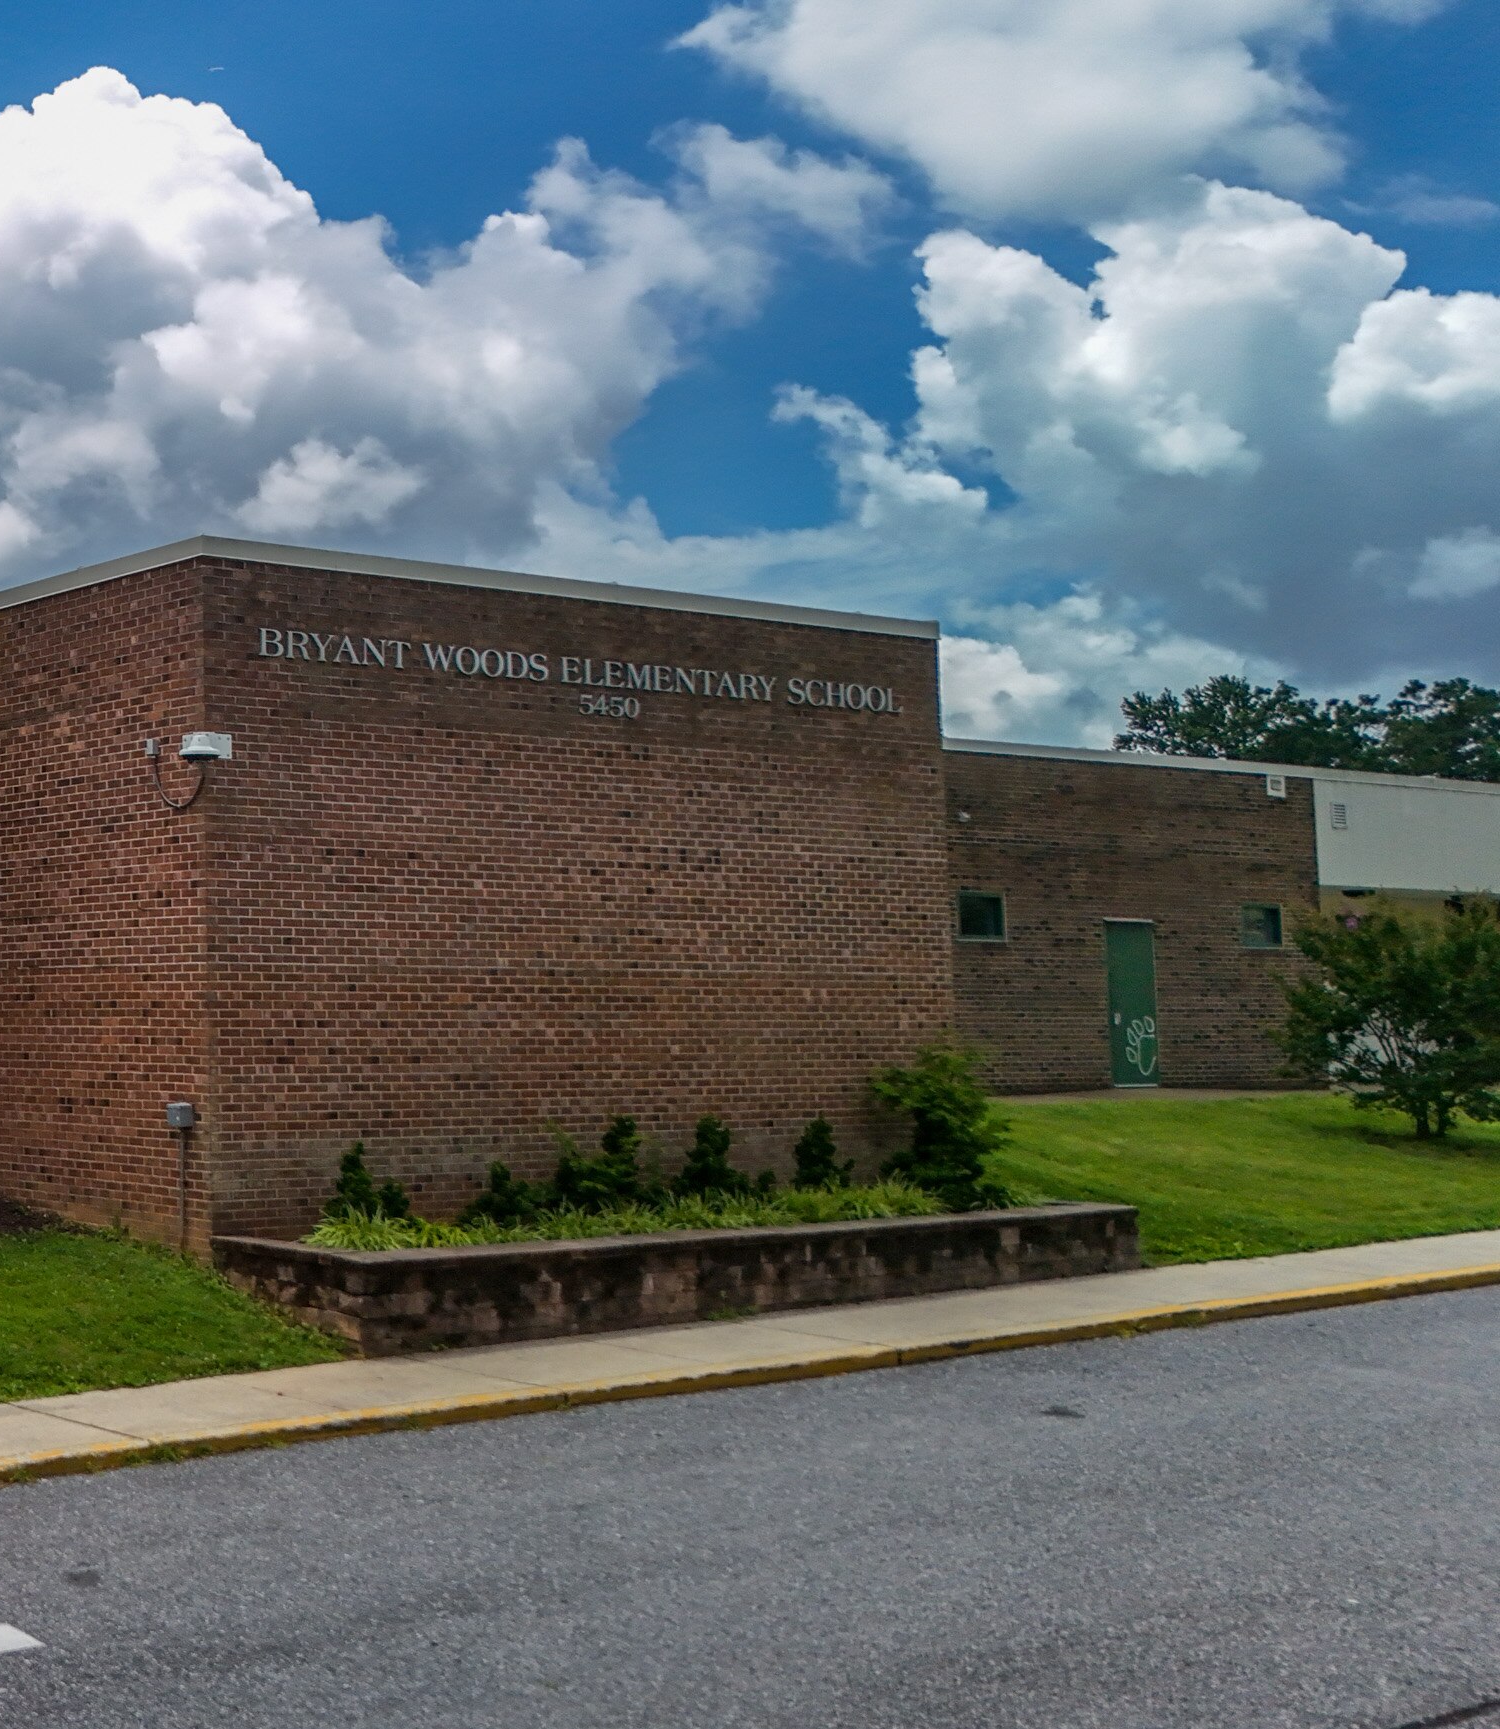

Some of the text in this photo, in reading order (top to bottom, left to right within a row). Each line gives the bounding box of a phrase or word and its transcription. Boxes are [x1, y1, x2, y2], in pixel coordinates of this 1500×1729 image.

[258, 627, 904, 714] BRYANT WOODS ELEMENTARY SCHOOL
[577, 693, 641, 719] 5450
